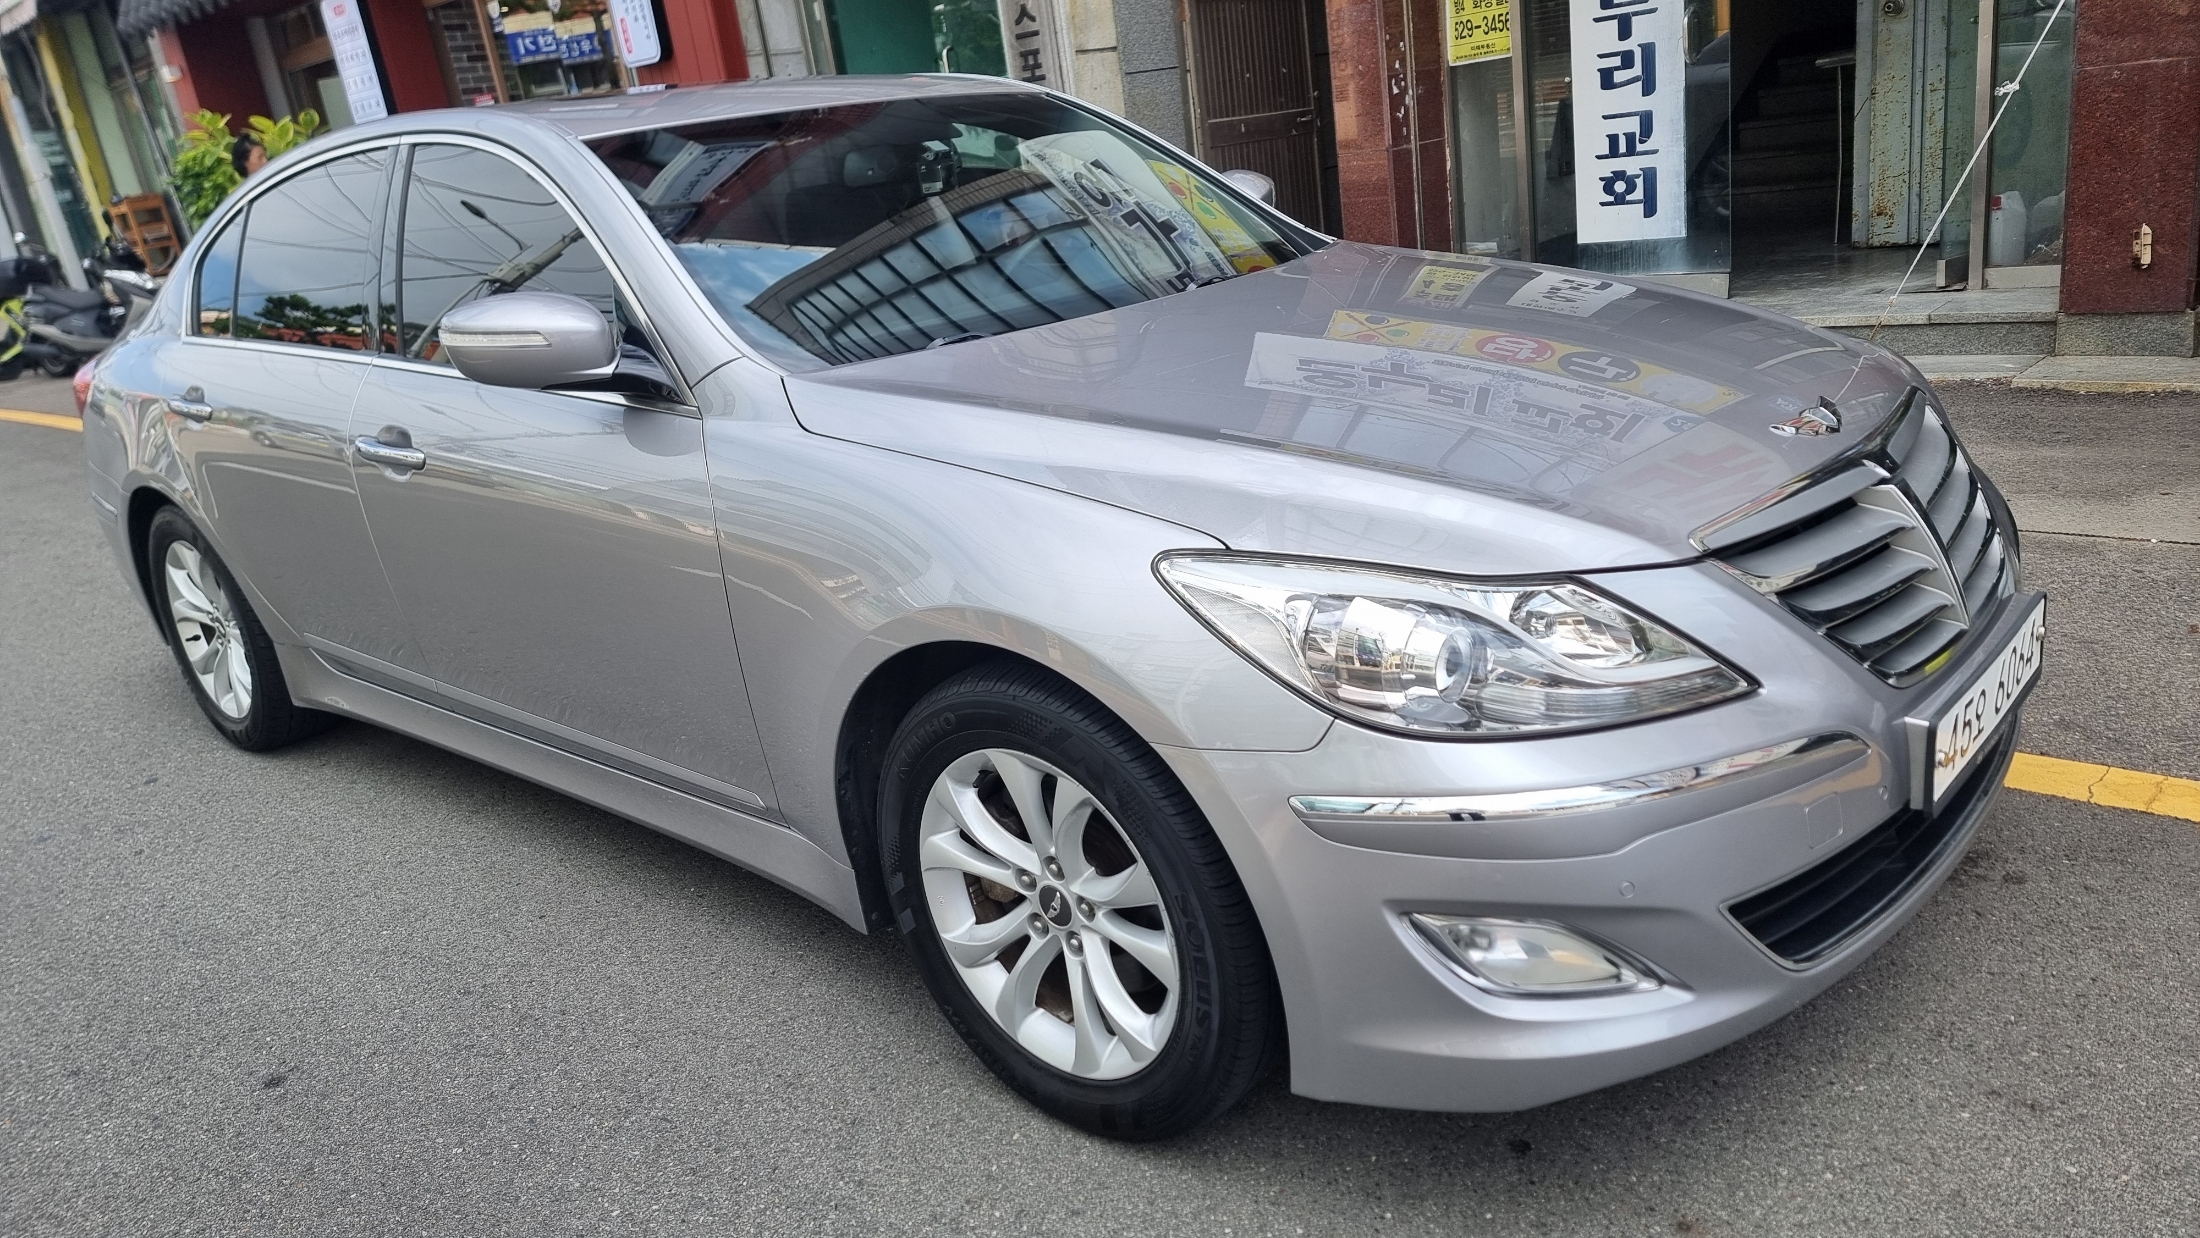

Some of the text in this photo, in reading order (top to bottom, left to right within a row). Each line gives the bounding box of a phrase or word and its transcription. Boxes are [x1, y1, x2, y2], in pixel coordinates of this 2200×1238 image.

[1014, 2, 1047, 83] 스포
[1454, 12, 1510, 41] 529-3456
[1993, 618, 2037, 716] 6064
[896, 711, 957, 779] KUMHO
[1174, 891, 1213, 1027] SOLUS
